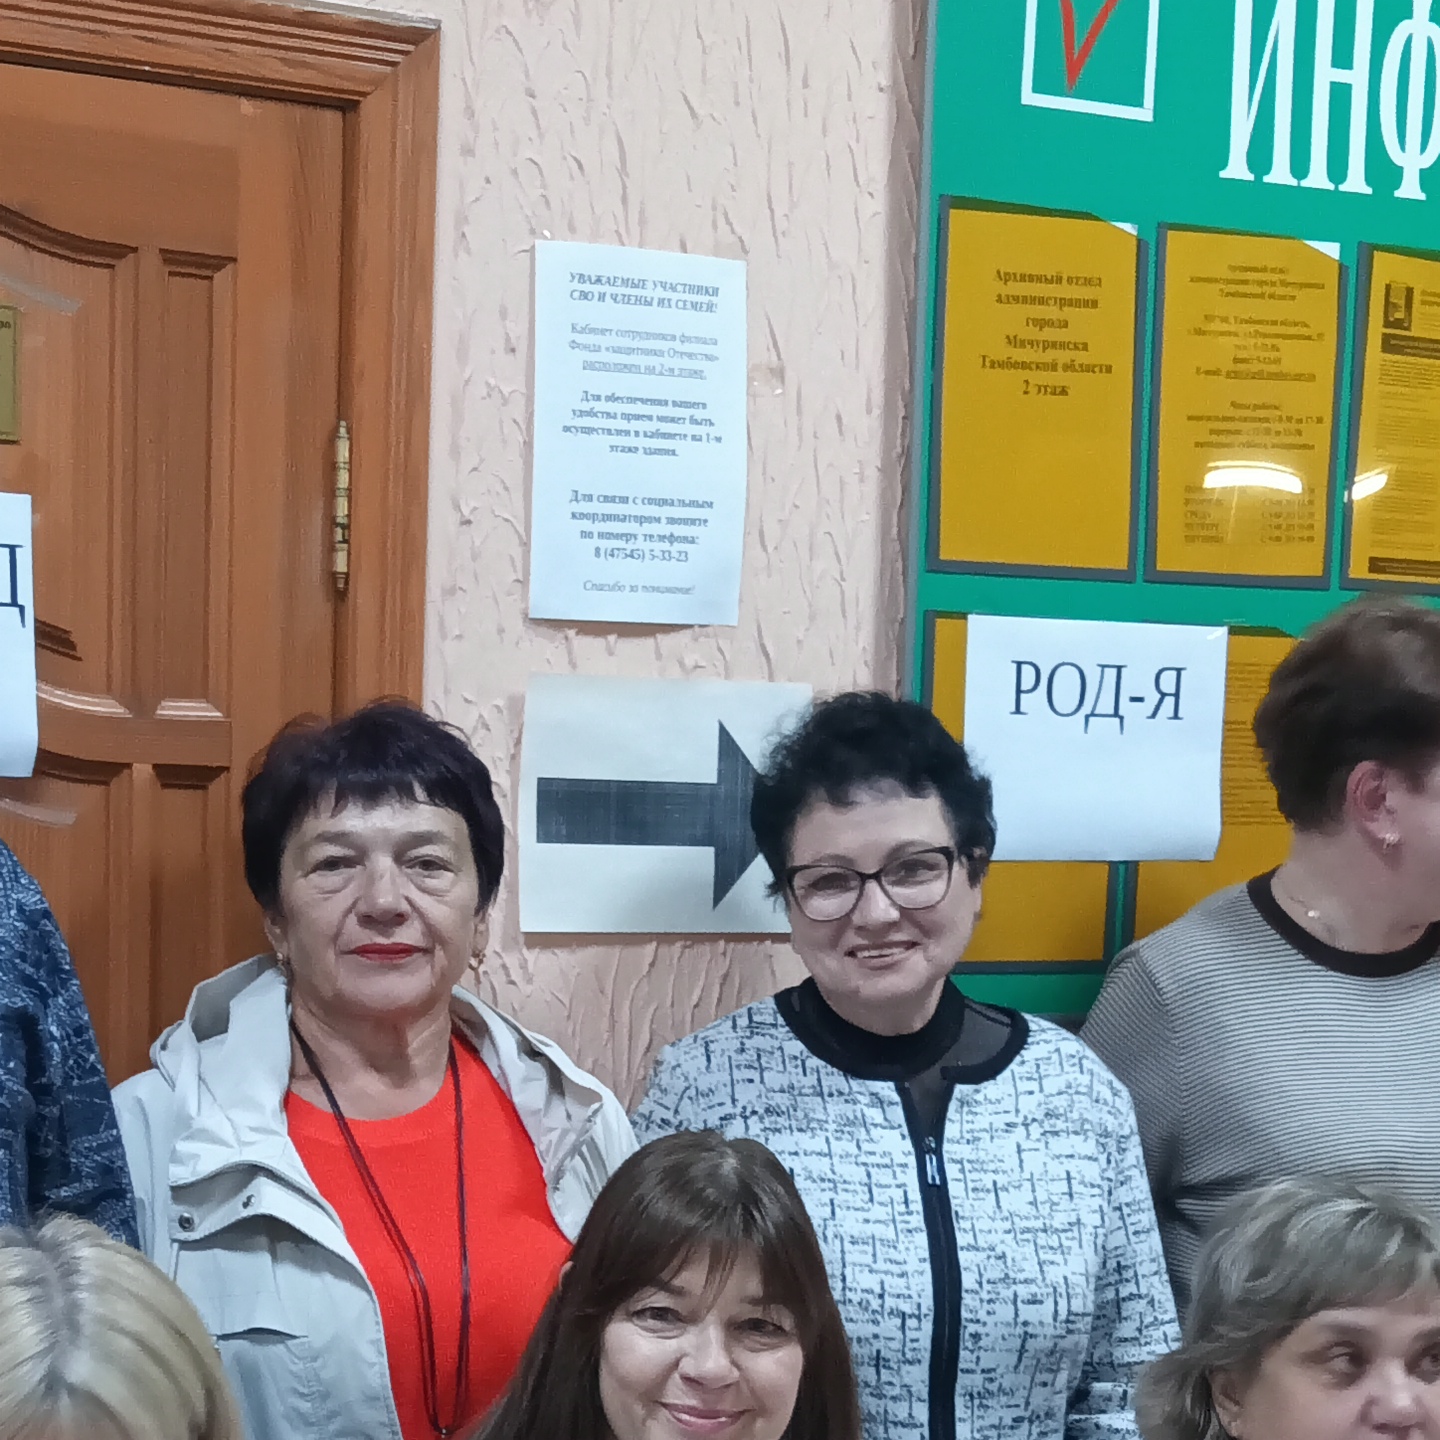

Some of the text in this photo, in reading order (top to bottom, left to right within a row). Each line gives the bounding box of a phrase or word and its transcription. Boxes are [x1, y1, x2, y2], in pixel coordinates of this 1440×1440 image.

[569, 272, 720, 298] УВАЖАЕМЫЕ УЧАСТНИКИ
[993, 269, 1102, 288] Архивный отдел
[570, 289, 718, 313] СВО И ЧЛЕНЫ ИХ СЕМЕЙ!
[995, 293, 1099, 312] администрации
[571, 322, 613, 335] Кабинет
[1026, 317, 1069, 332] города
[568, 339, 601, 353] Фонда
[1005, 334, 1089, 353] Мичуринска
[980, 355, 1059, 373] Тамбовской
[1022, 379, 1030, 395] 2
[580, 390, 602, 403] Для
[569, 489, 714, 509] Для связи с социальным
[570, 511, 661, 527] координатором
[580, 530, 594, 540] по
[597, 531, 638, 545] номеру
[594, 546, 602, 559] 8
[1009, 660, 1187, 735] РОД-Я
